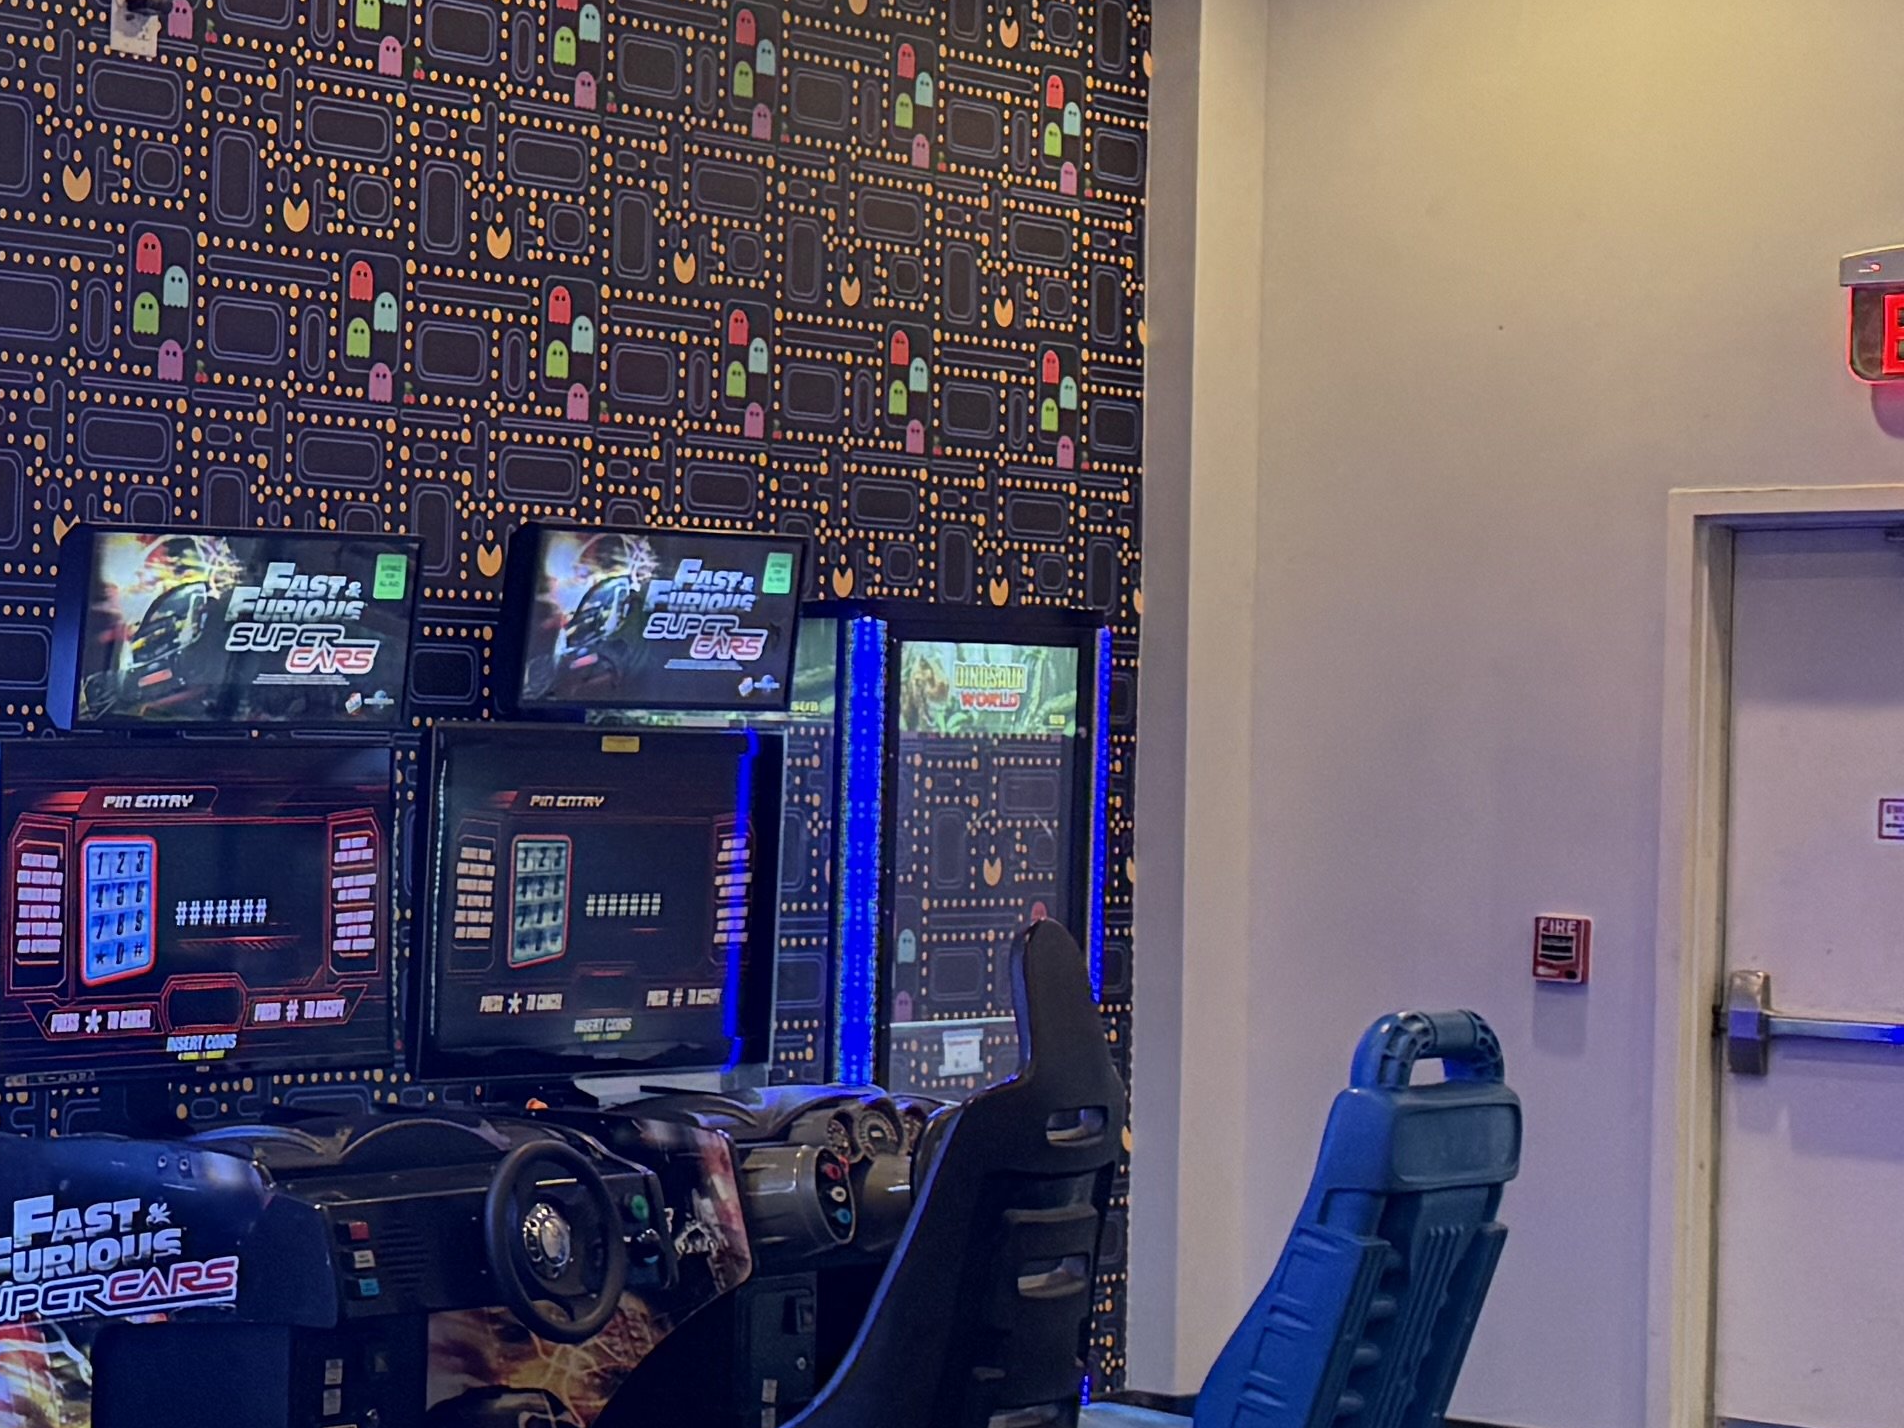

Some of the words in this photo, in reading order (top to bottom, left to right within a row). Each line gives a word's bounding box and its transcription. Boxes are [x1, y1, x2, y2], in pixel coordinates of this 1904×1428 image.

[261, 562, 347, 598] FAST
[674, 559, 743, 591] FAST
[225, 586, 365, 622] FURIOUS
[643, 580, 757, 612] FURIOUS
[225, 622, 380, 652] SUPER
[643, 613, 768, 639] SUPER
[285, 646, 376, 674] CARS
[690, 634, 764, 660] CARS
[954, 662, 1027, 693] DINOSAUR
[958, 691, 1020, 711] WORLD
[103, 795, 133, 808] PIN
[135, 794, 194, 808] ENTRY
[530, 795, 554, 807] PIN
[556, 795, 605, 807] ENTRY
[1539, 919, 1577, 933] FIRE
[13, 1195, 141, 1249] FAST
